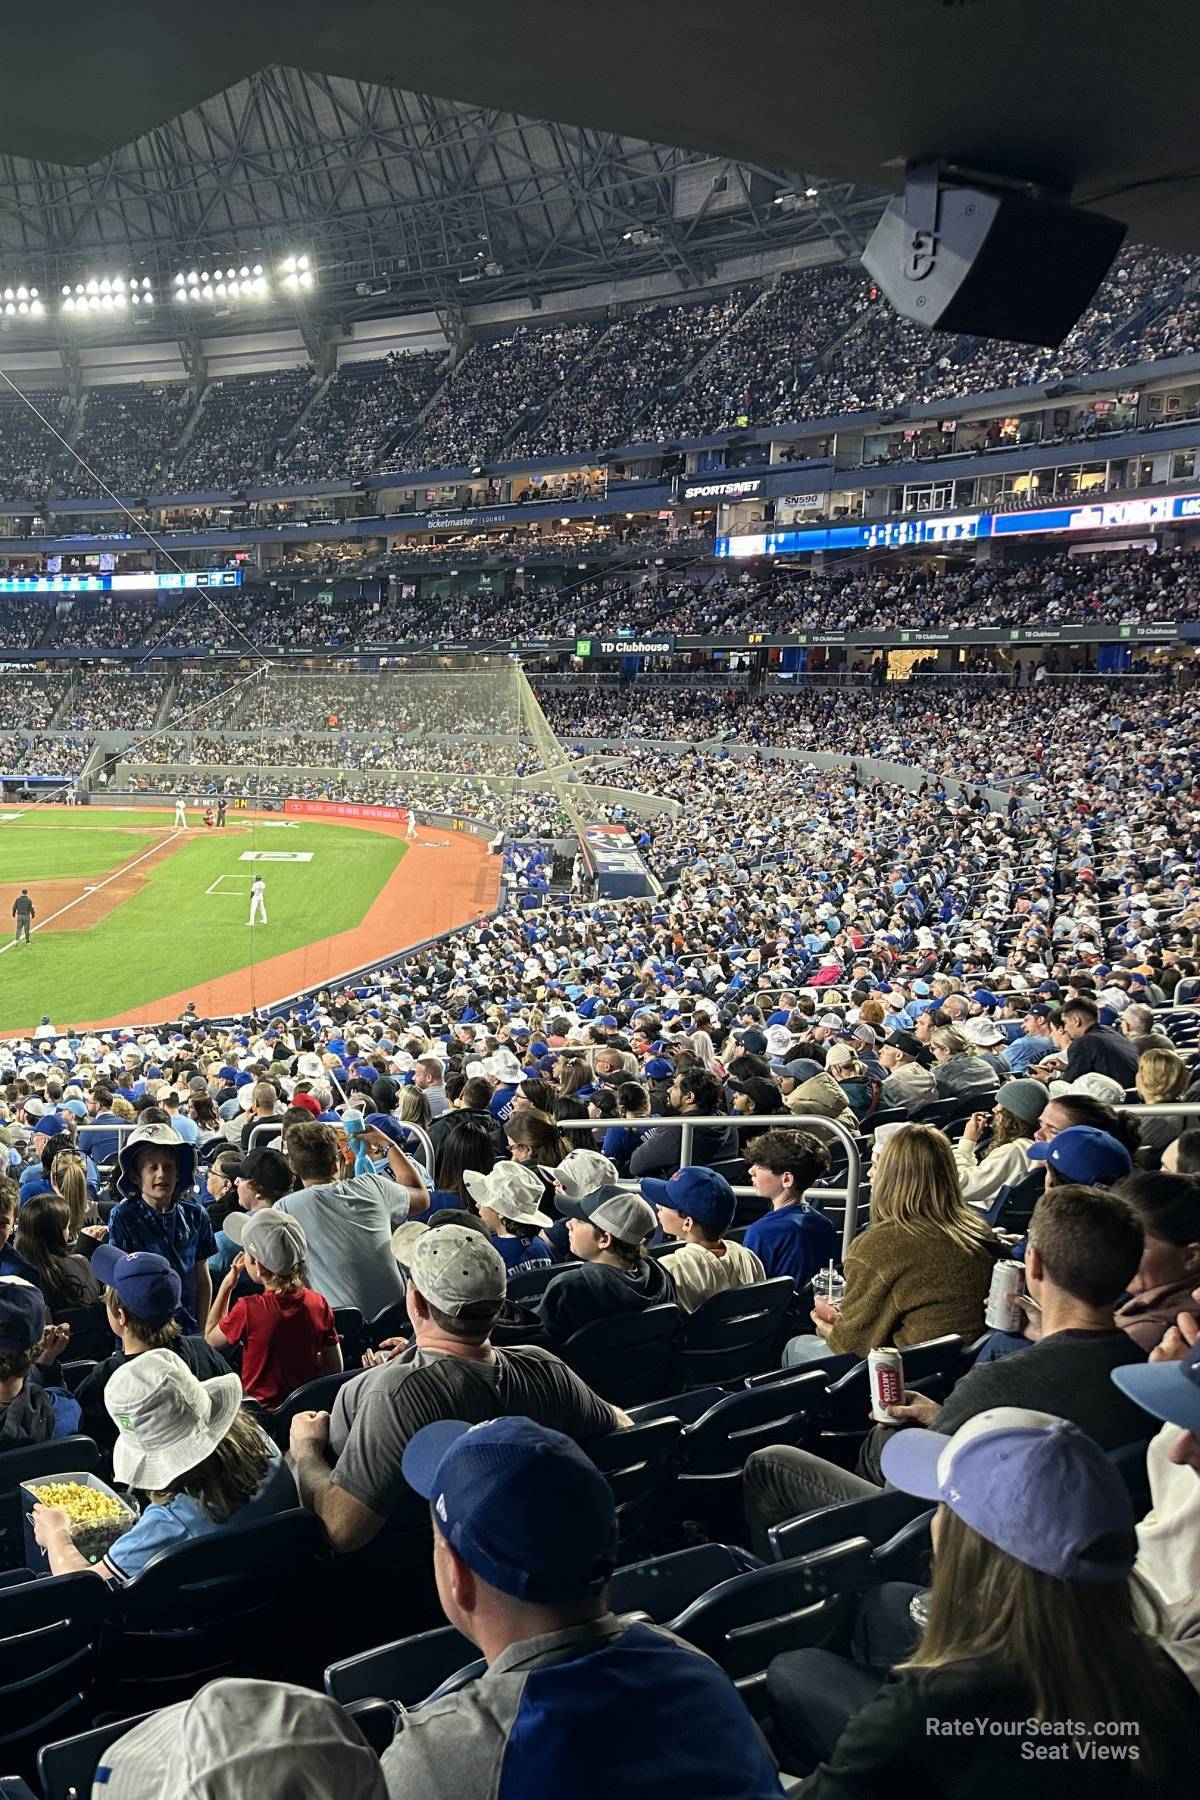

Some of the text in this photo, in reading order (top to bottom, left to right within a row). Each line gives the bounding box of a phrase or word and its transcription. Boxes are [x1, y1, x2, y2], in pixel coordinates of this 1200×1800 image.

[685, 480, 760, 498] SPORTSNET
[785, 495, 817, 505] SN590
[428, 518, 475, 529] ticketmaster
[601, 642, 669, 652] TD Clubhouse
[882, 1371, 891, 1402] ARTOIS
[889, 1372, 898, 1402] STELLA
